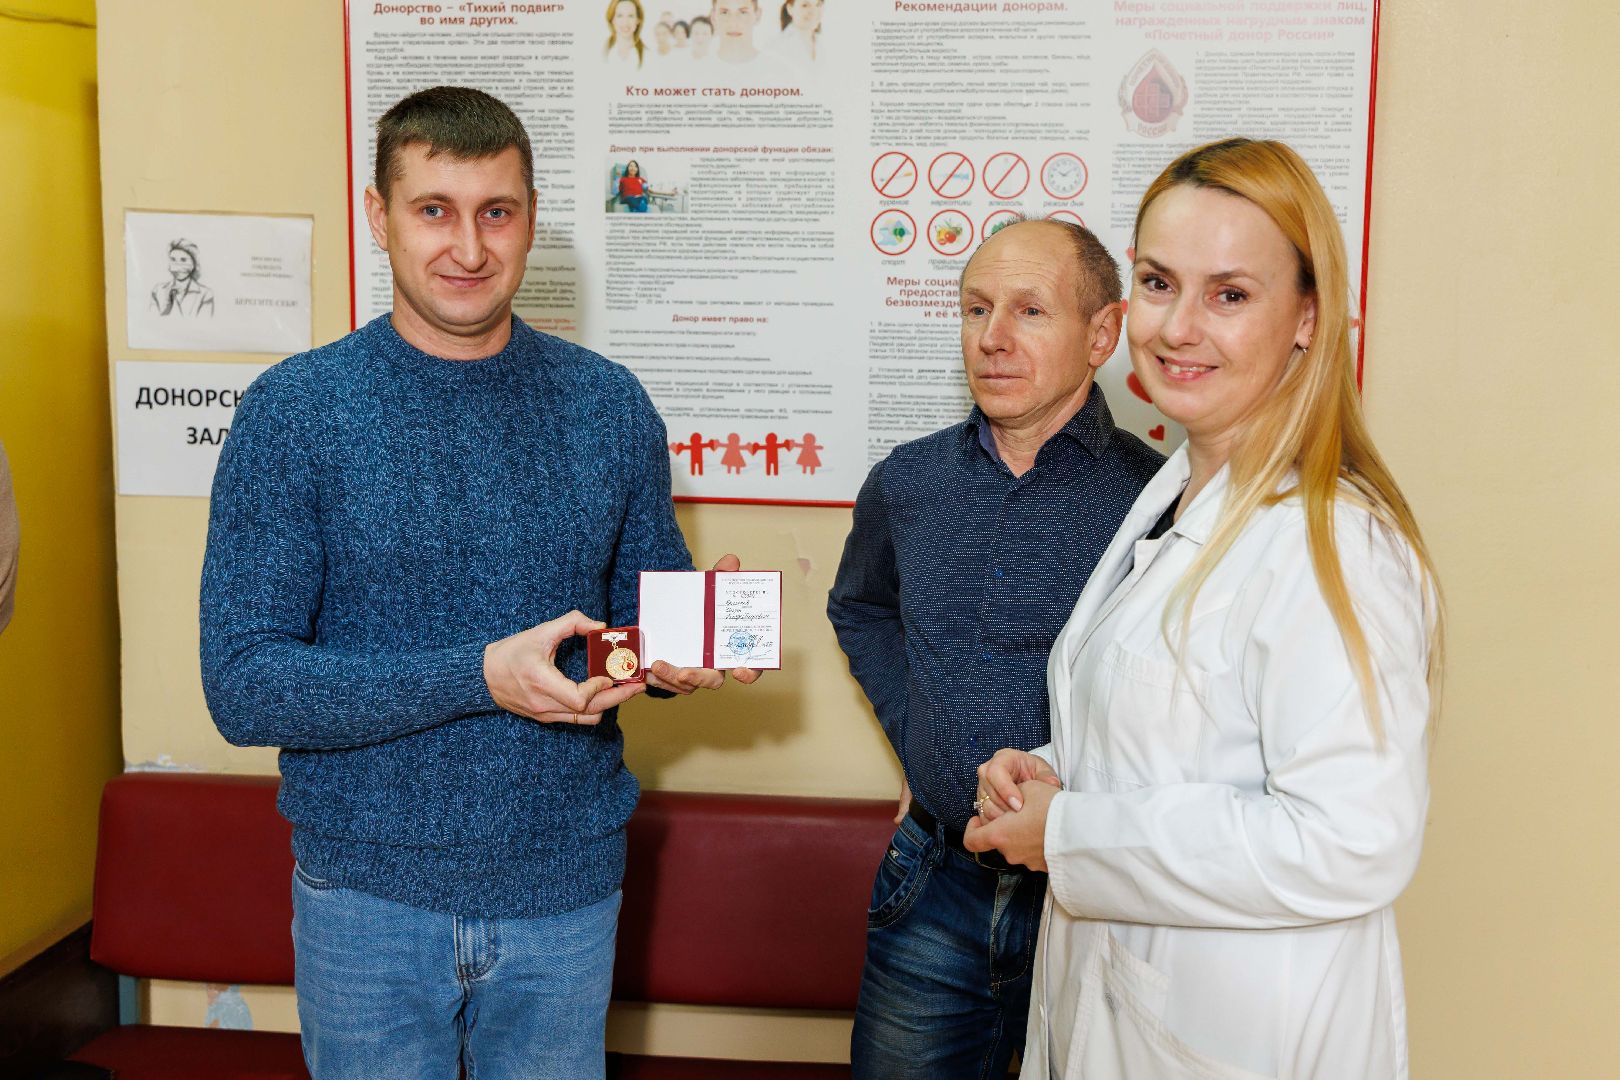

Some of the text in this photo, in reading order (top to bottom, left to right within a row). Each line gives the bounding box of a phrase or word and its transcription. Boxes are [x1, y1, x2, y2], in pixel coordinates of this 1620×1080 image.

[373, 3, 442, 15] Донорство
[459, 2, 507, 13] «Тихий
[511, 4, 565, 15] подвиг»
[894, 1, 1068, 14] Рекомендации донорам.
[1113, 0, 1368, 14] Меры социальной поддержки лиц,
[420, 16, 518, 27] во имя других.
[1115, 17, 1365, 29] награжденных нагрудным знаком
[1145, 28, 1335, 43] «Почетный донор России»
[626, 86, 804, 98] Кто может стать донором.
[609, 145, 637, 154] Донор
[713, 146, 759, 154] донорской
[761, 146, 799, 155] функции
[886, 276, 961, 287] Меры социа
[899, 288, 961, 298] предостав
[935, 309, 948, 318] её
[672, 315, 699, 325] Донор
[729, 317, 754, 325] право
[135, 386, 245, 409] ДОНОРСК
